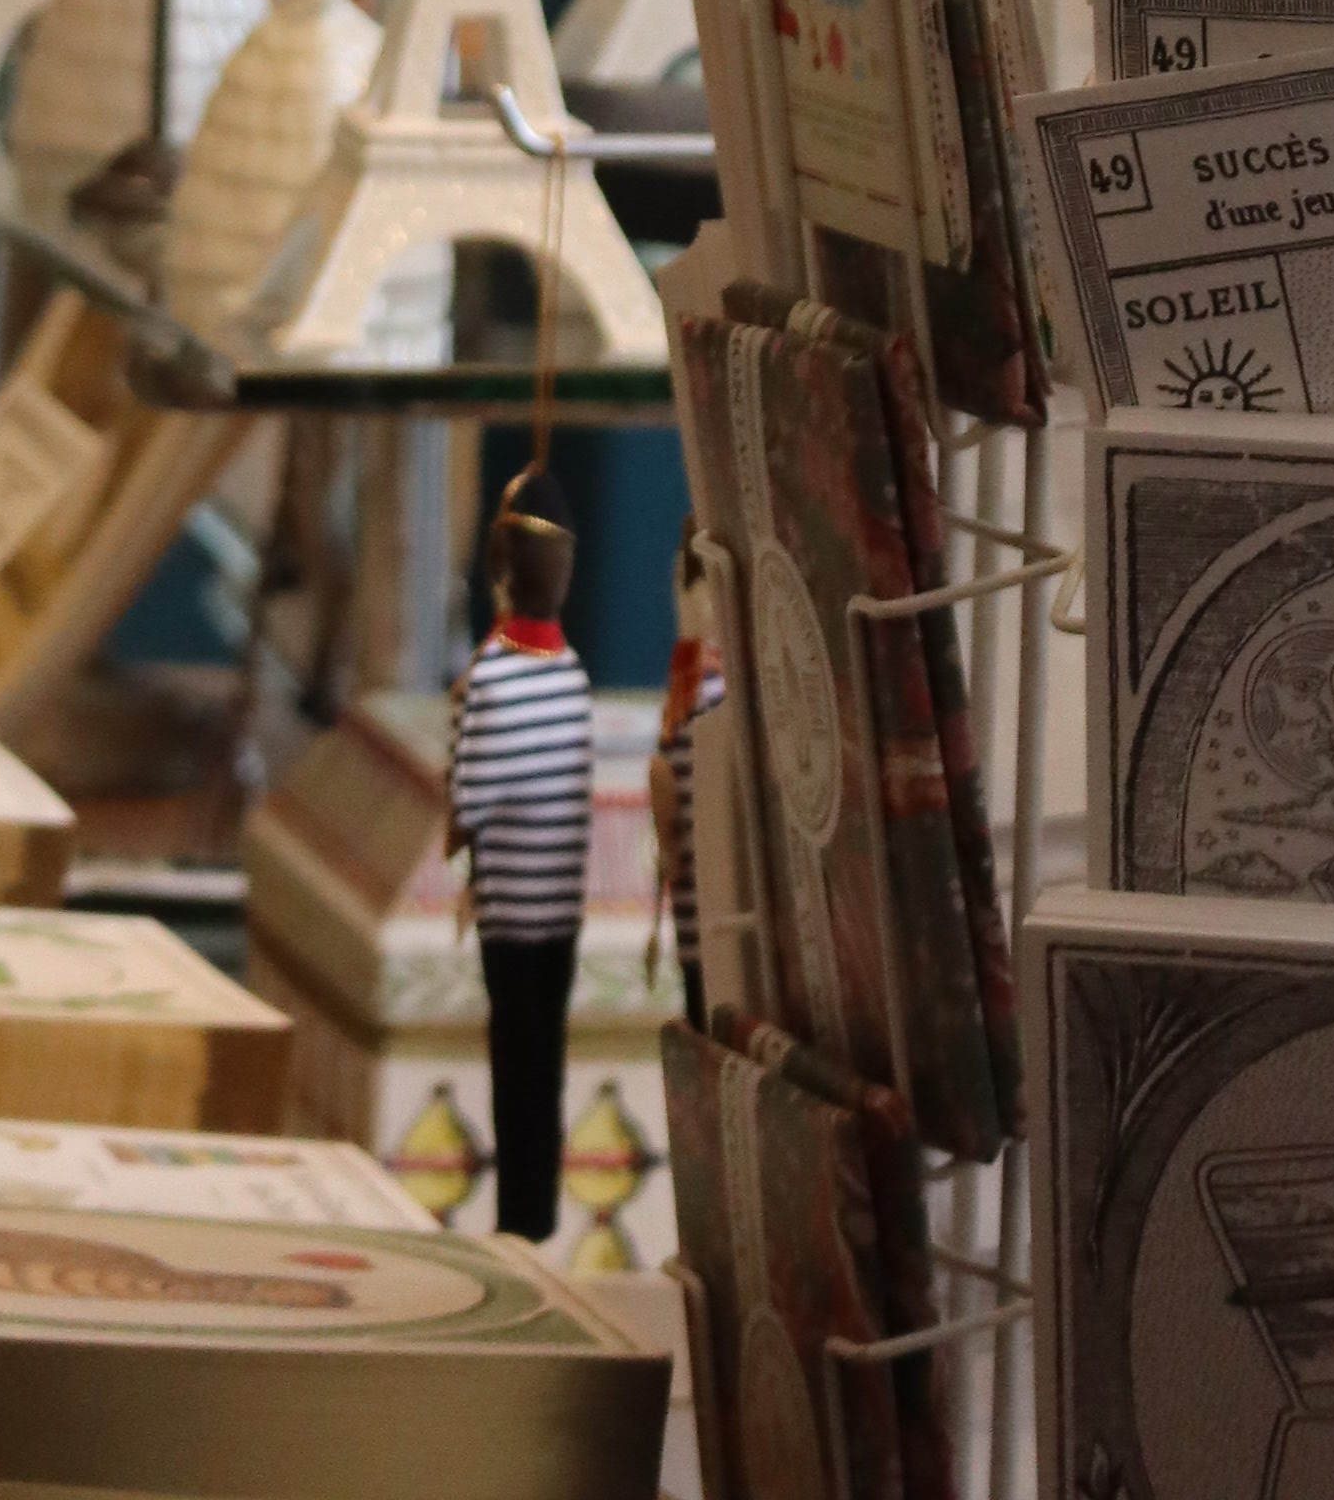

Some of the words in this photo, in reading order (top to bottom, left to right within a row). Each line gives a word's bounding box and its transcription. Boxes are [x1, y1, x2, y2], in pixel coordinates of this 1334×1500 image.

[1152, 36, 1197, 72] 49
[1089, 154, 1134, 194] 49
[1193, 133, 1330, 183] SUCCÈS
[1206, 200, 1282, 231] d'une
[1125, 281, 1280, 329] SOLEIL
